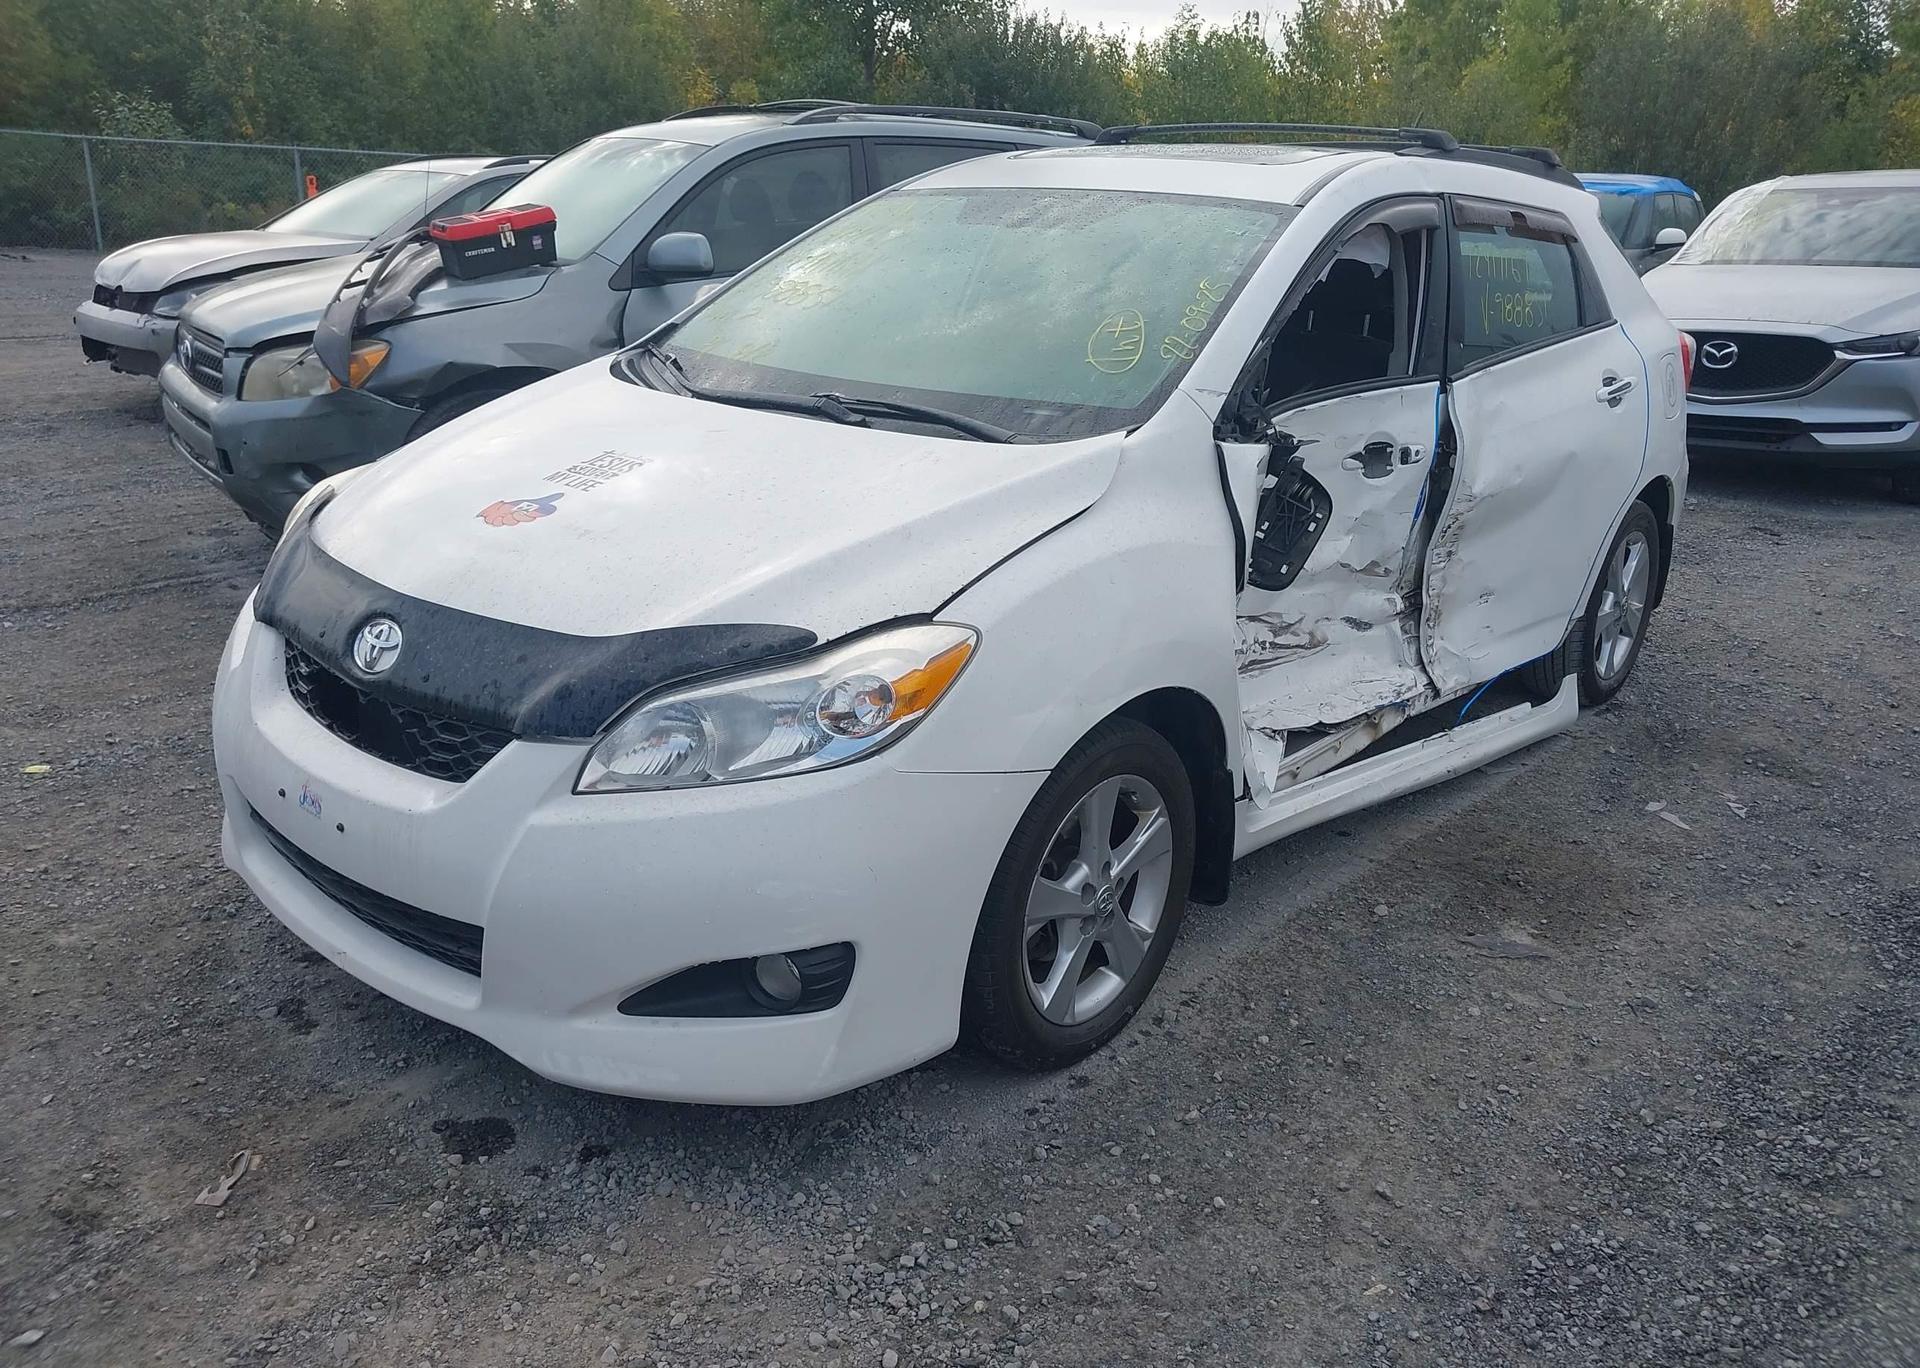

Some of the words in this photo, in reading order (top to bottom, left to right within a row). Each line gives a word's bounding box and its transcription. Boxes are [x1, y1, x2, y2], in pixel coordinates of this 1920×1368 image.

[464, 247, 496, 257] CRAFTSMAN
[581, 450, 645, 474] JESUS
[542, 471, 571, 484] MY
[564, 476, 605, 492] LIFE
